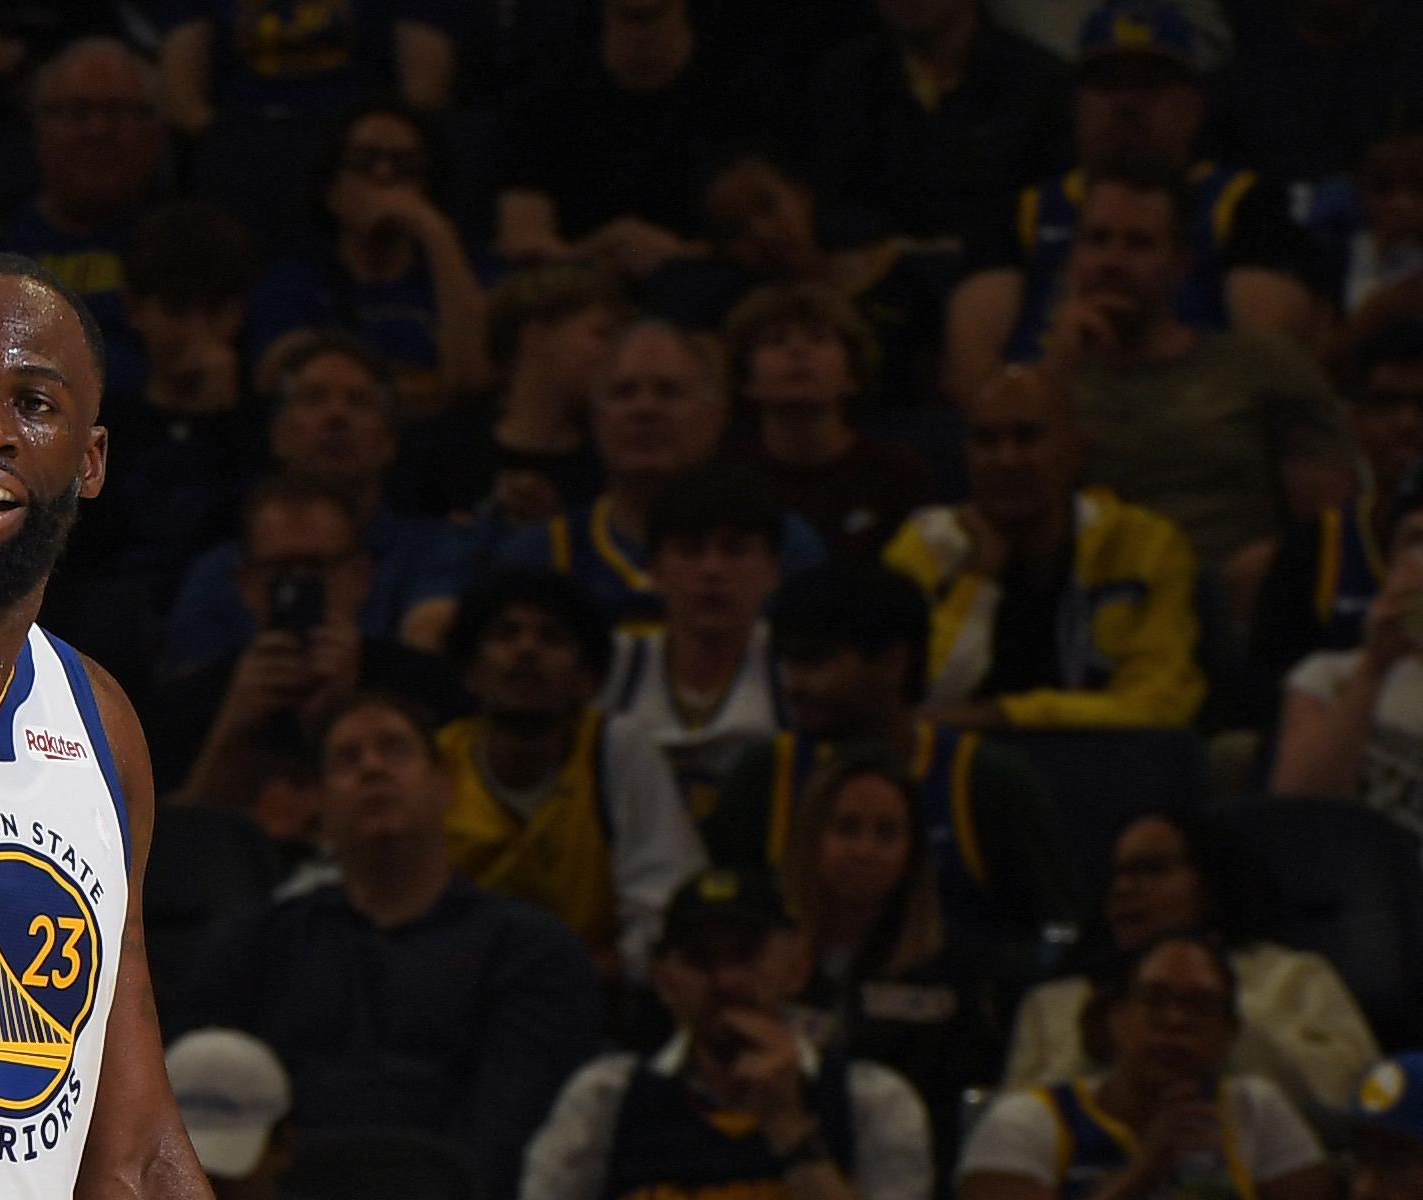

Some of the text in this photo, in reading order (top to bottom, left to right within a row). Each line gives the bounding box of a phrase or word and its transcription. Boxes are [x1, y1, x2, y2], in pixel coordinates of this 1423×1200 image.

[25, 728, 88, 759] Rakuten
[32, 821, 105, 905] STATE
[20, 913, 87, 990] 23
